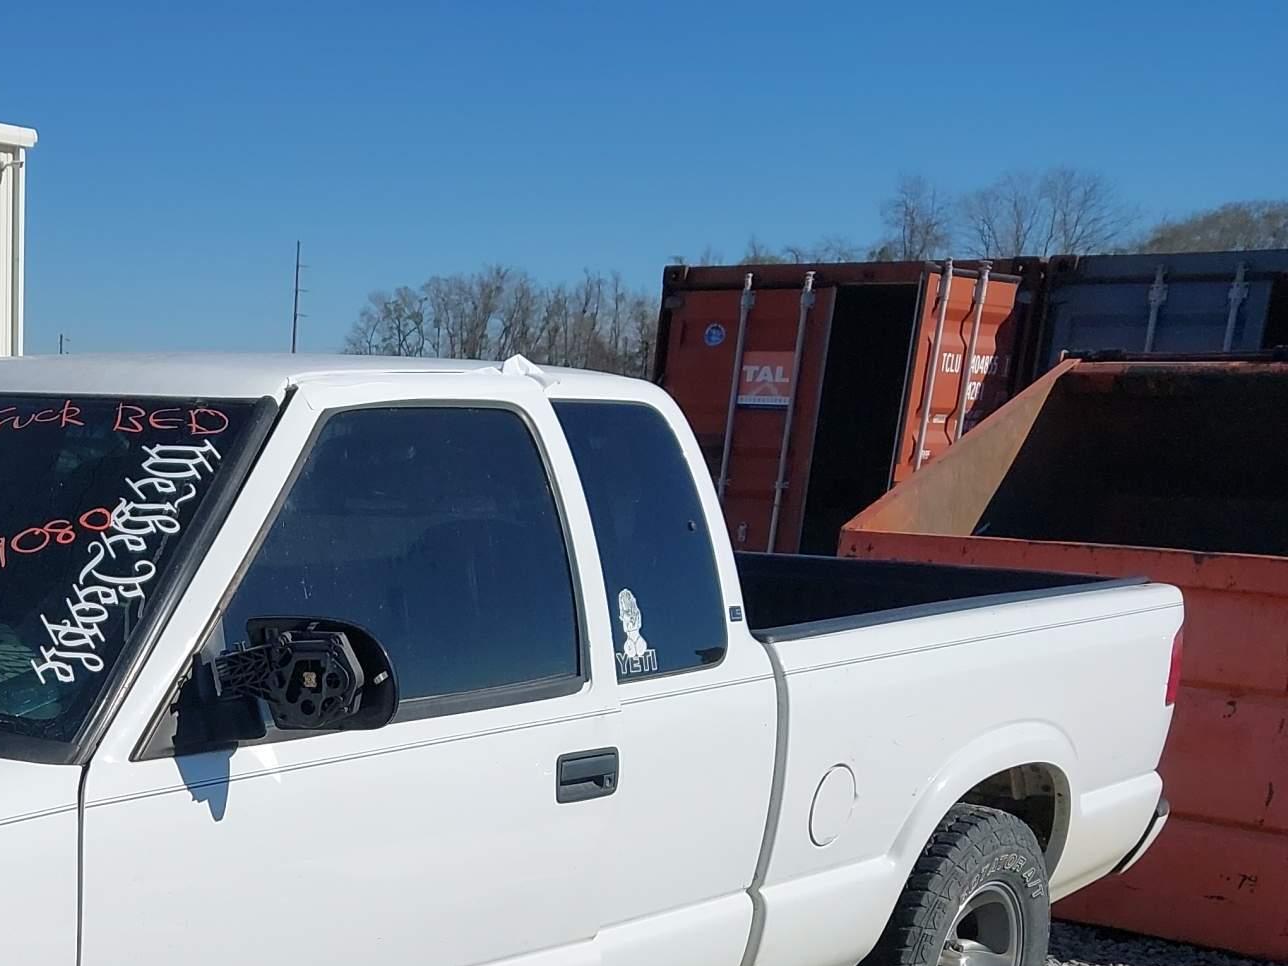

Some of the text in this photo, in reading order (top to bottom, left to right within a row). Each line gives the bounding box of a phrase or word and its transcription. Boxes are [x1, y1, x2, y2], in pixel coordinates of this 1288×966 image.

[742, 365, 790, 383] TAL
[941, 352, 962, 374] TCLU
[113, 402, 230, 436] BED
[616, 648, 658, 674] YETI
[1022, 867, 1046, 899] A/T
